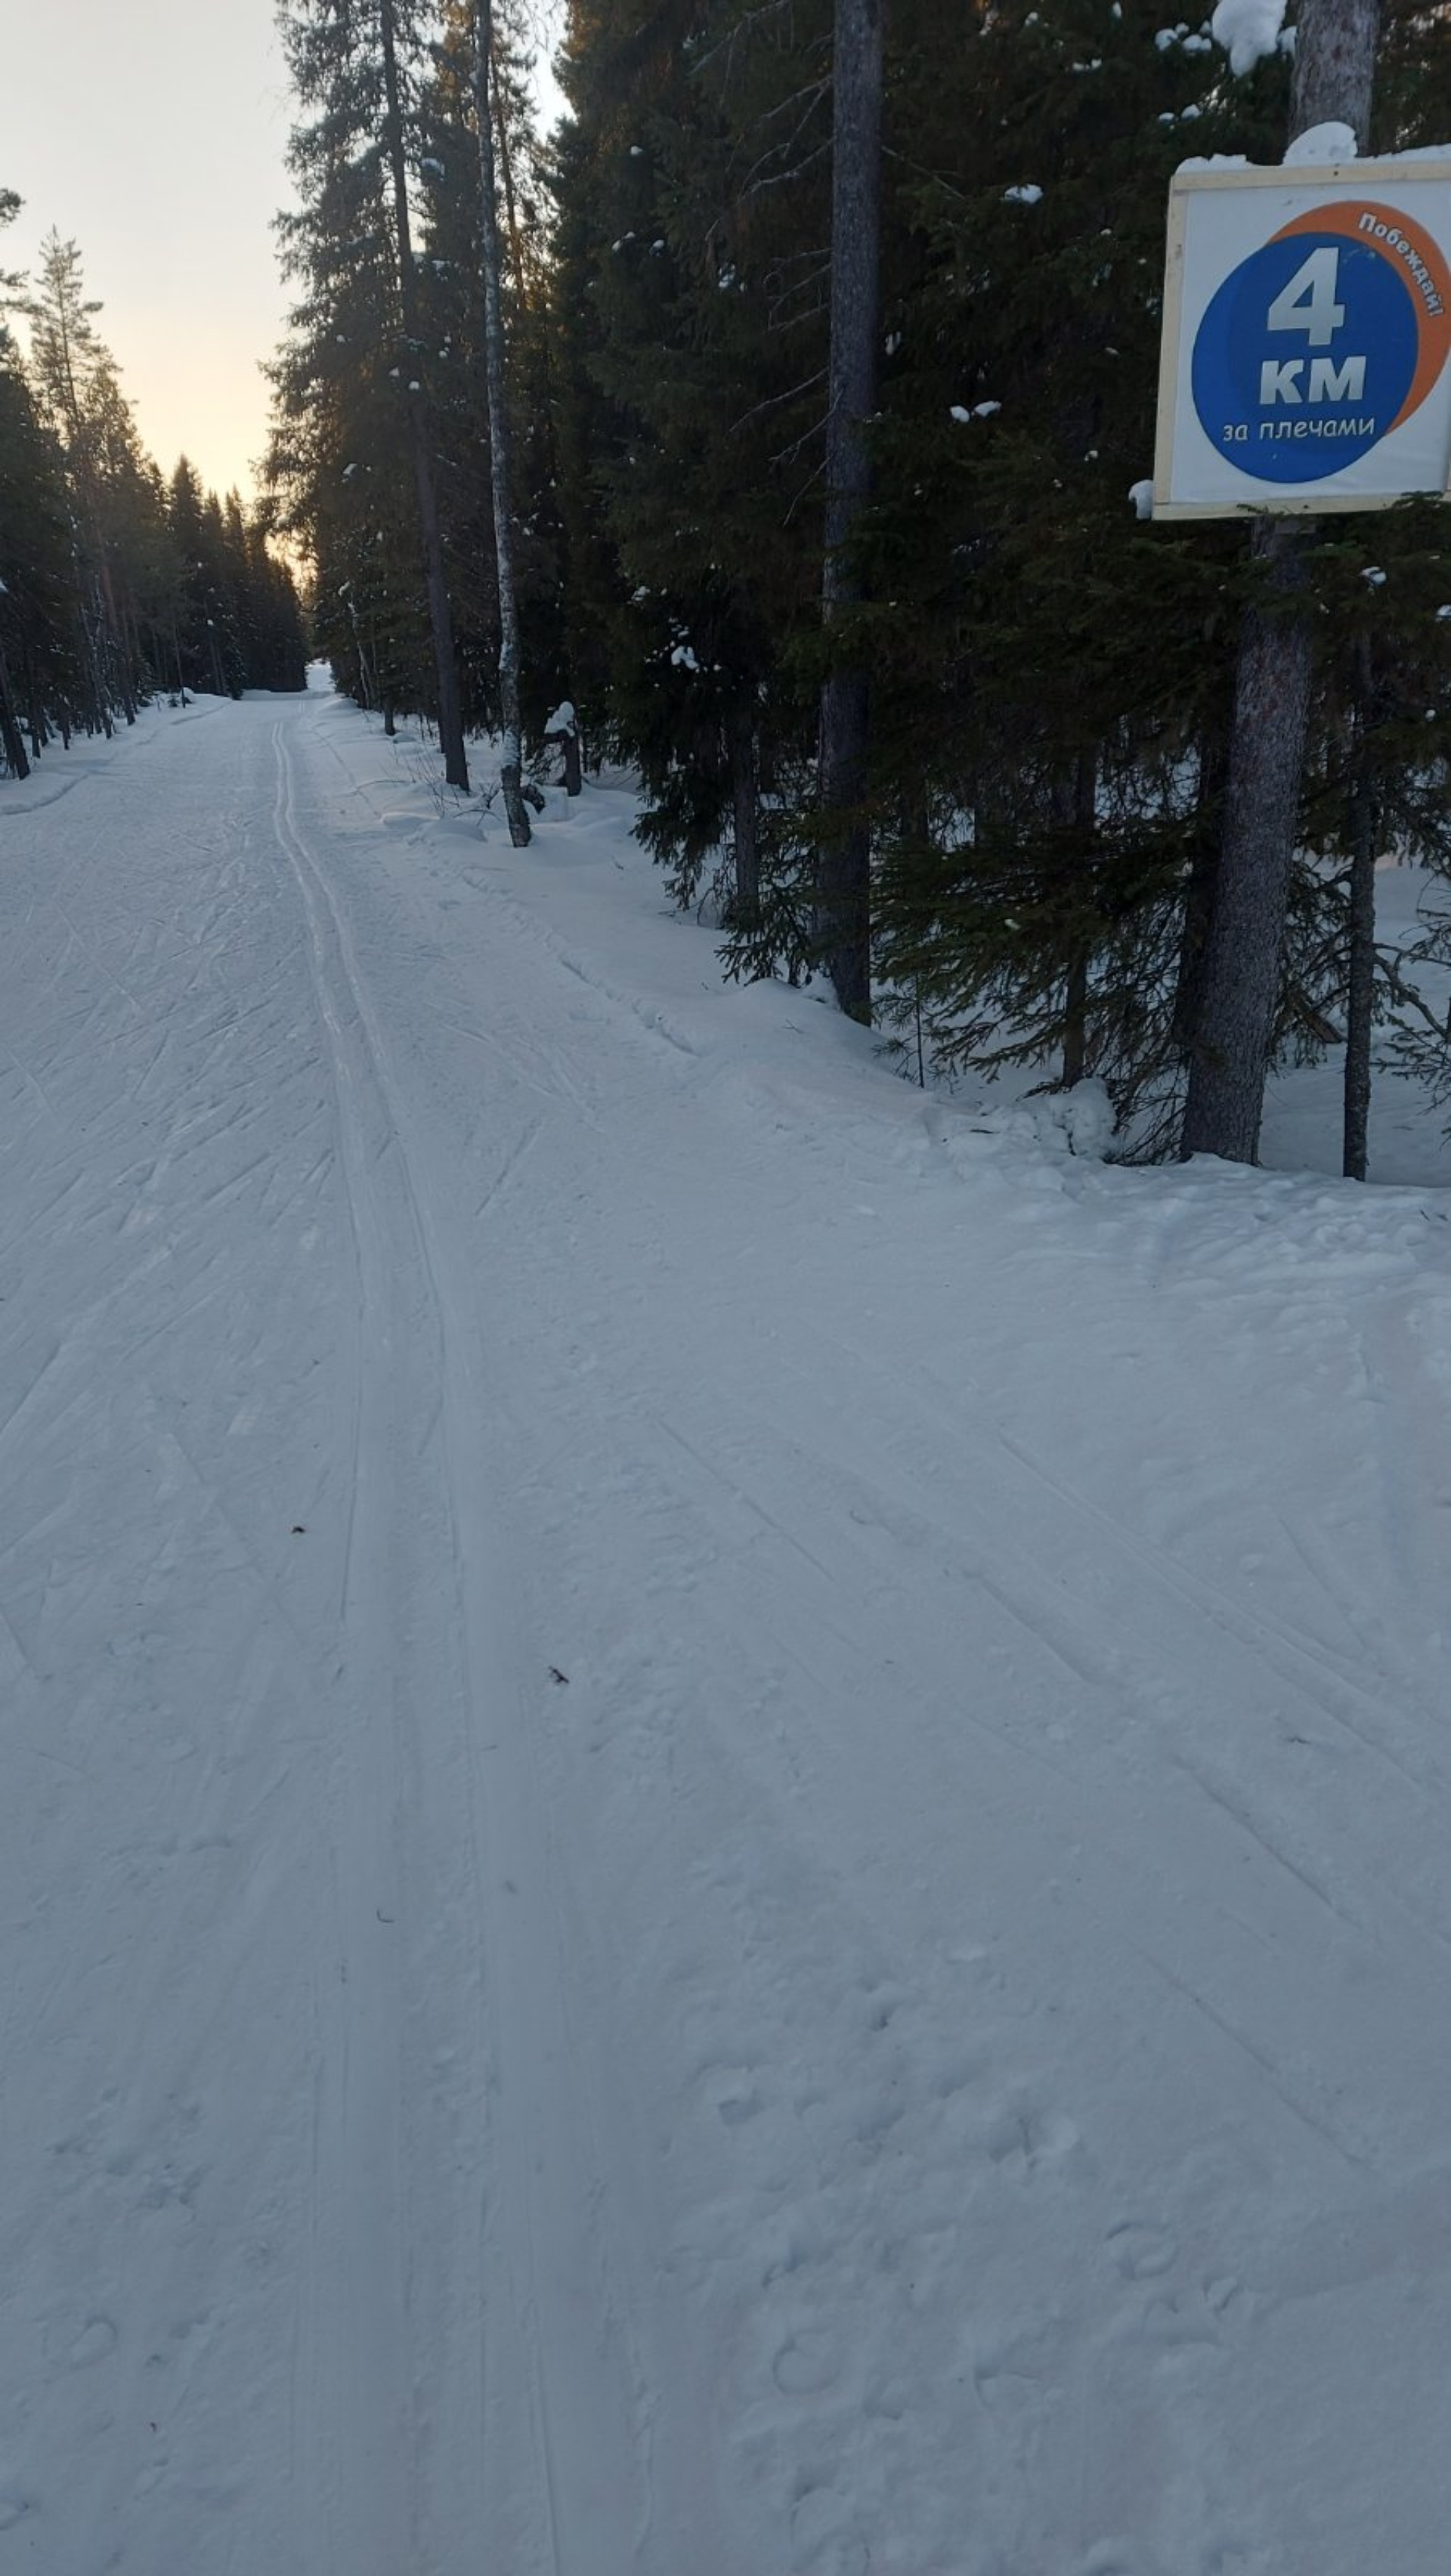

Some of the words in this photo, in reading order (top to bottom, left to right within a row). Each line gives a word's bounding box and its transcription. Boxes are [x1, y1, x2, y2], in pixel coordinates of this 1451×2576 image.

[1267, 248, 1344, 346] 4
[1358, 212, 1443, 317] Побеждай!
[1223, 424, 1248, 441] за
[1260, 417, 1375, 440] плечами
